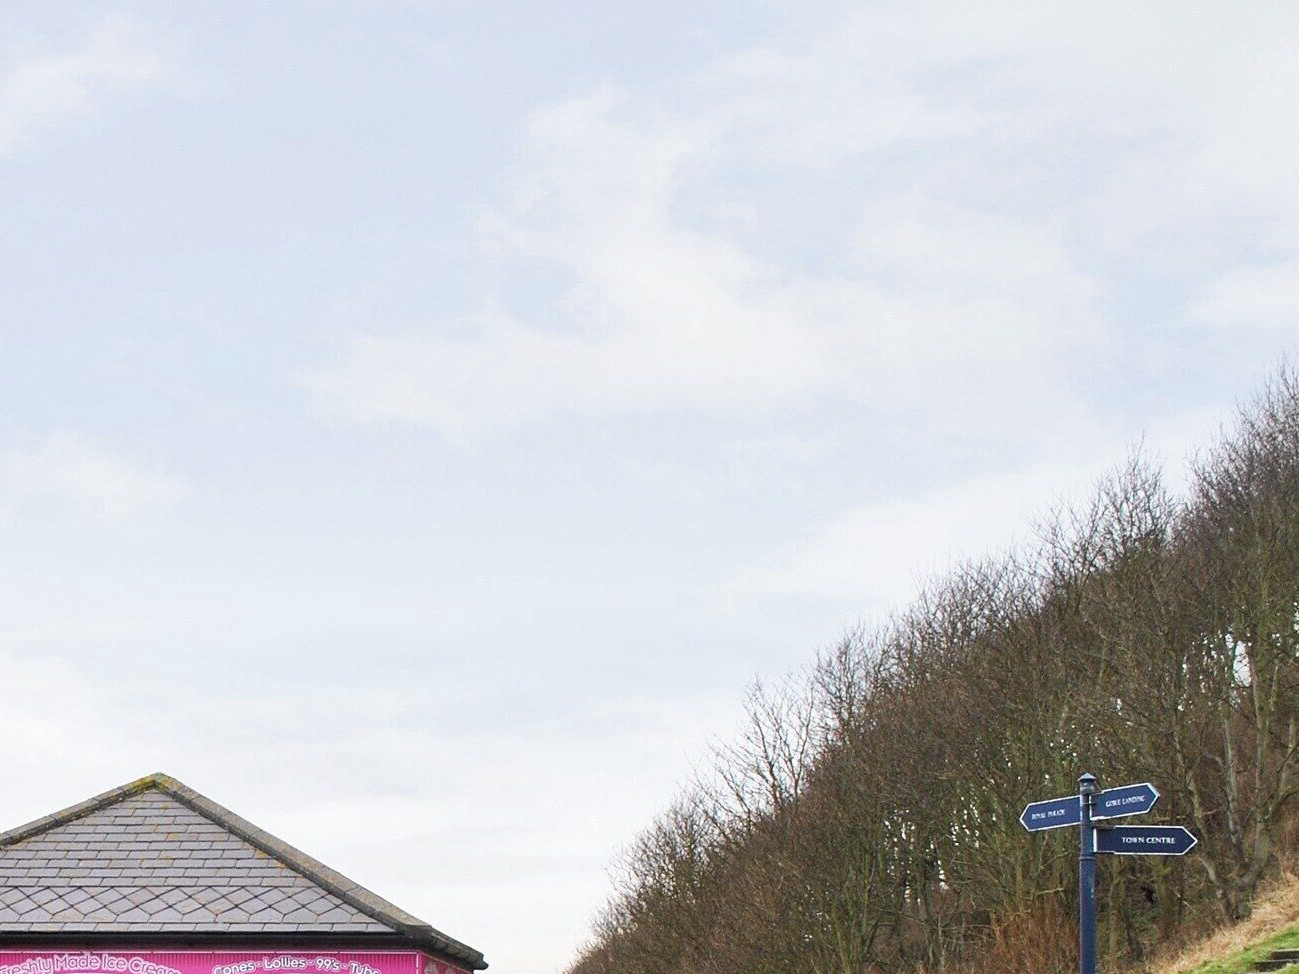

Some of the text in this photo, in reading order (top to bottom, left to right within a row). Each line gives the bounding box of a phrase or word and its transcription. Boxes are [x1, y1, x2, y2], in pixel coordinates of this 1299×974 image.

[1121, 836, 1176, 845] TOWN CENTRE
[54, 954, 100, 971] Made
[103, 954, 127, 970] Ice
[263, 957, 306, 970] Lollies
[316, 957, 341, 971] 99's
